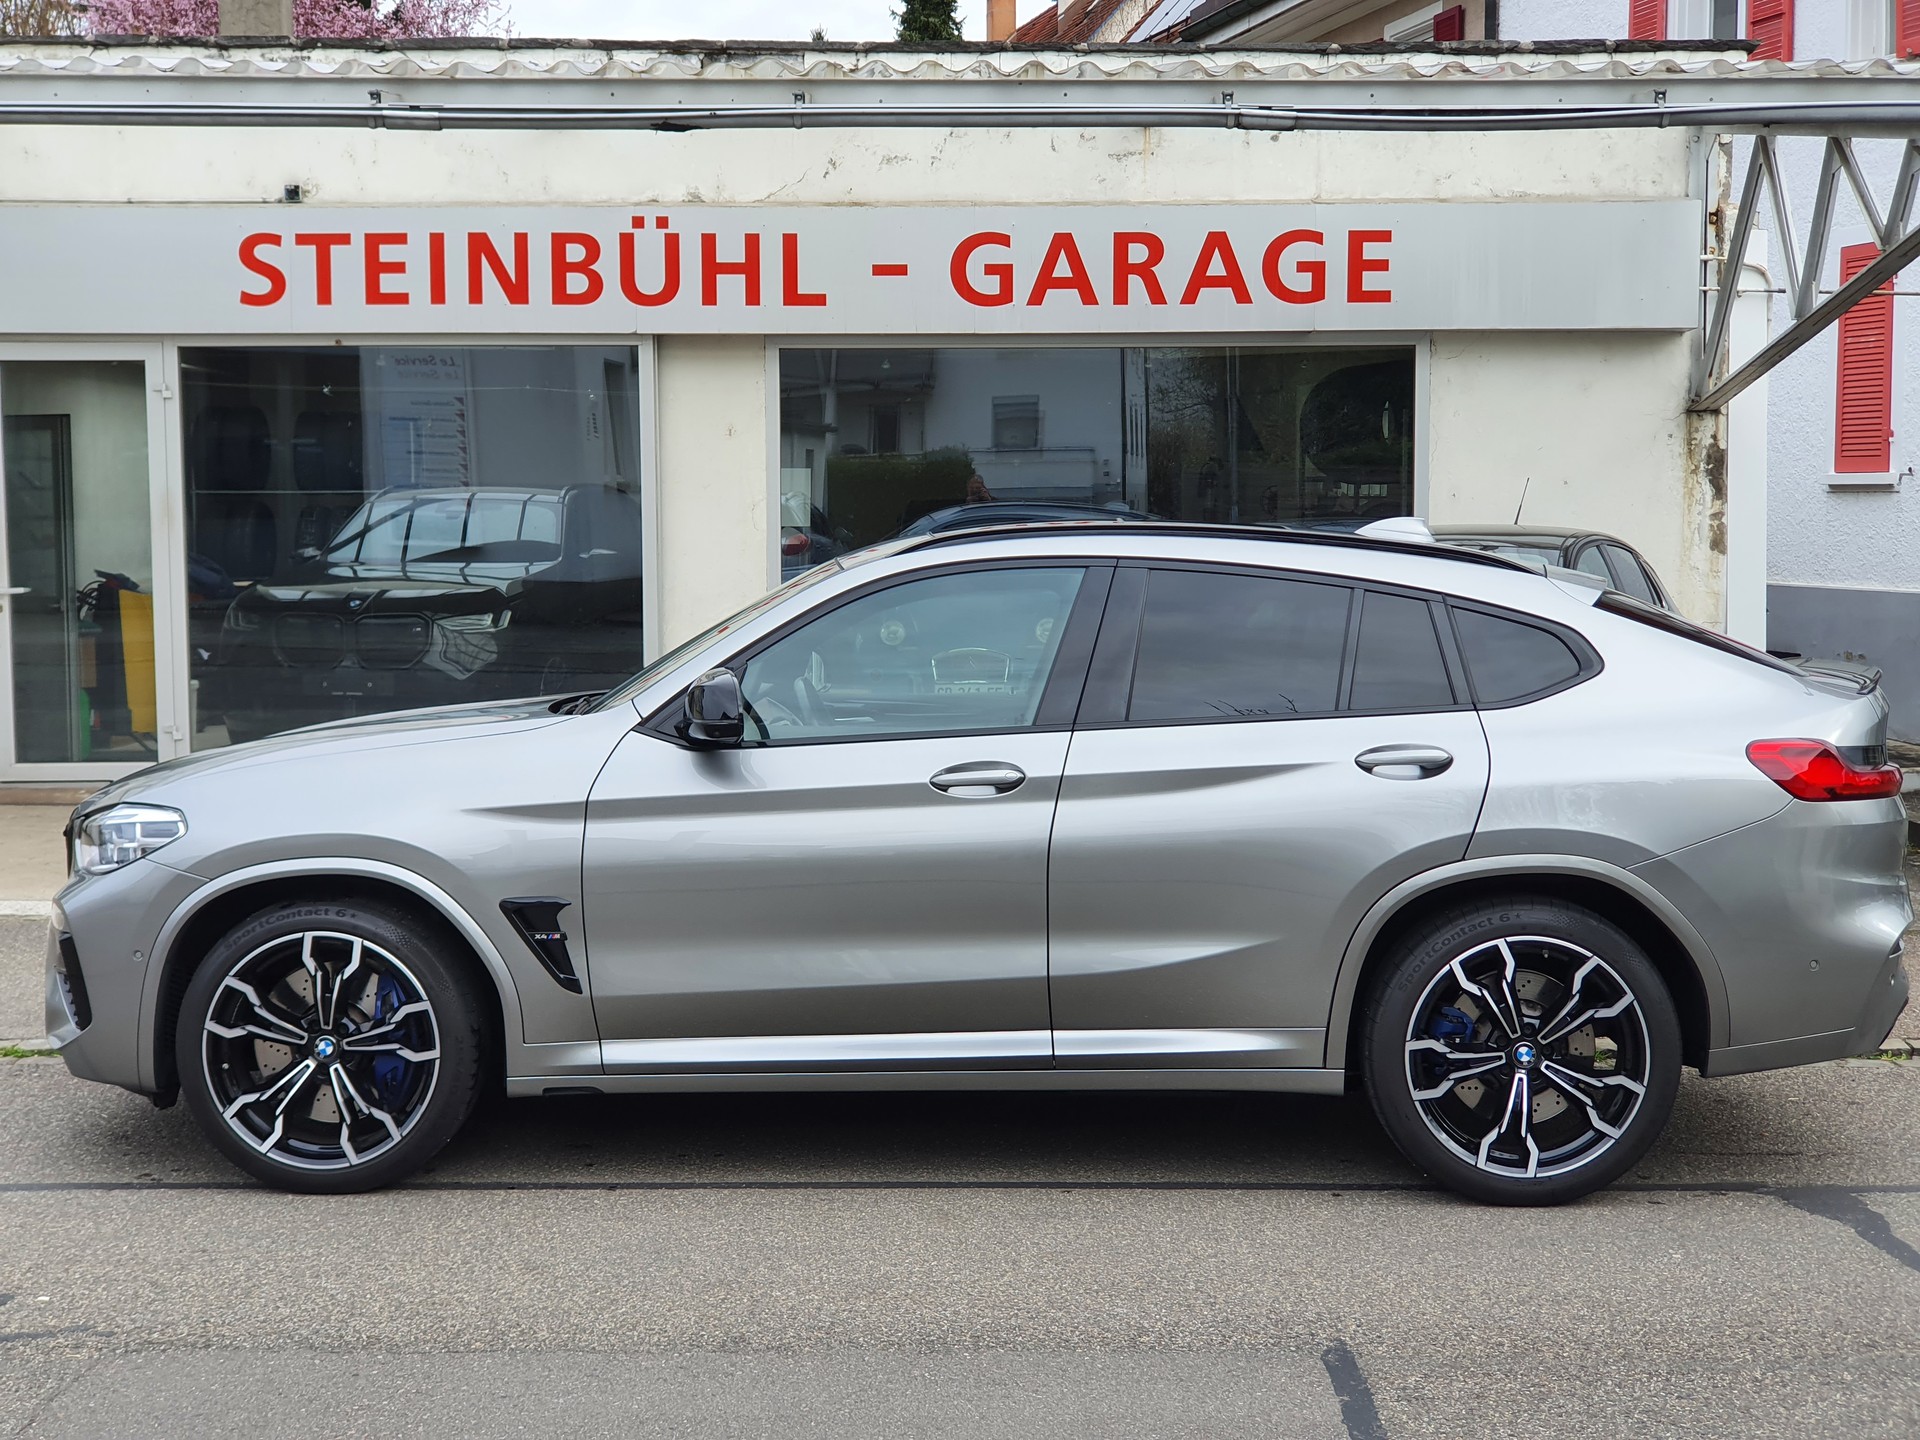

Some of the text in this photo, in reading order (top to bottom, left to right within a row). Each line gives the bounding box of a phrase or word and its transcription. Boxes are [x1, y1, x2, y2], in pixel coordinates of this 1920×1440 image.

[239, 216, 827, 306] STEINBÜHL
[950, 230, 1393, 306] GARAGE
[223, 908, 347, 951] SportContact 6
[1398, 912, 1511, 991] SportContact 6
